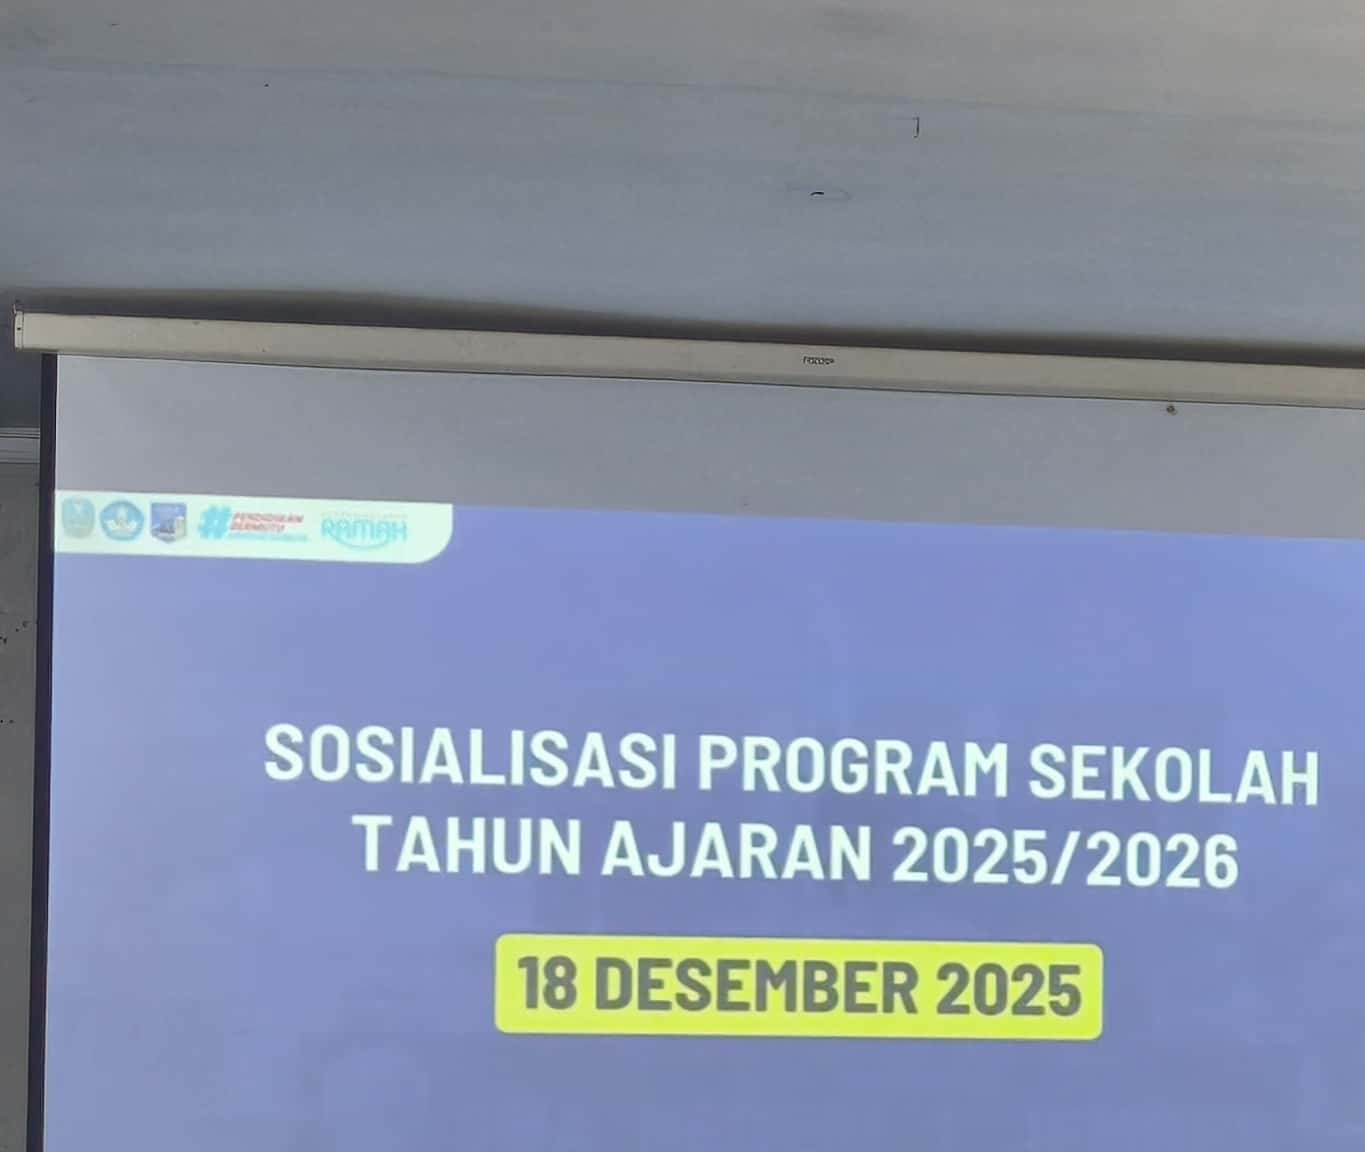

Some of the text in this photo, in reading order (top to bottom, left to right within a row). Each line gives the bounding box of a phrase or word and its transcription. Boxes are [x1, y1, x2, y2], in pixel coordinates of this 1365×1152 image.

[265, 723, 1318, 806] SOSIALISASI PROGRAM SEKOLAH
[351, 814, 1238, 889] TAHUN AJARAN 2025/2026
[518, 955, 1081, 1017] 18 DESEMBER 2025
